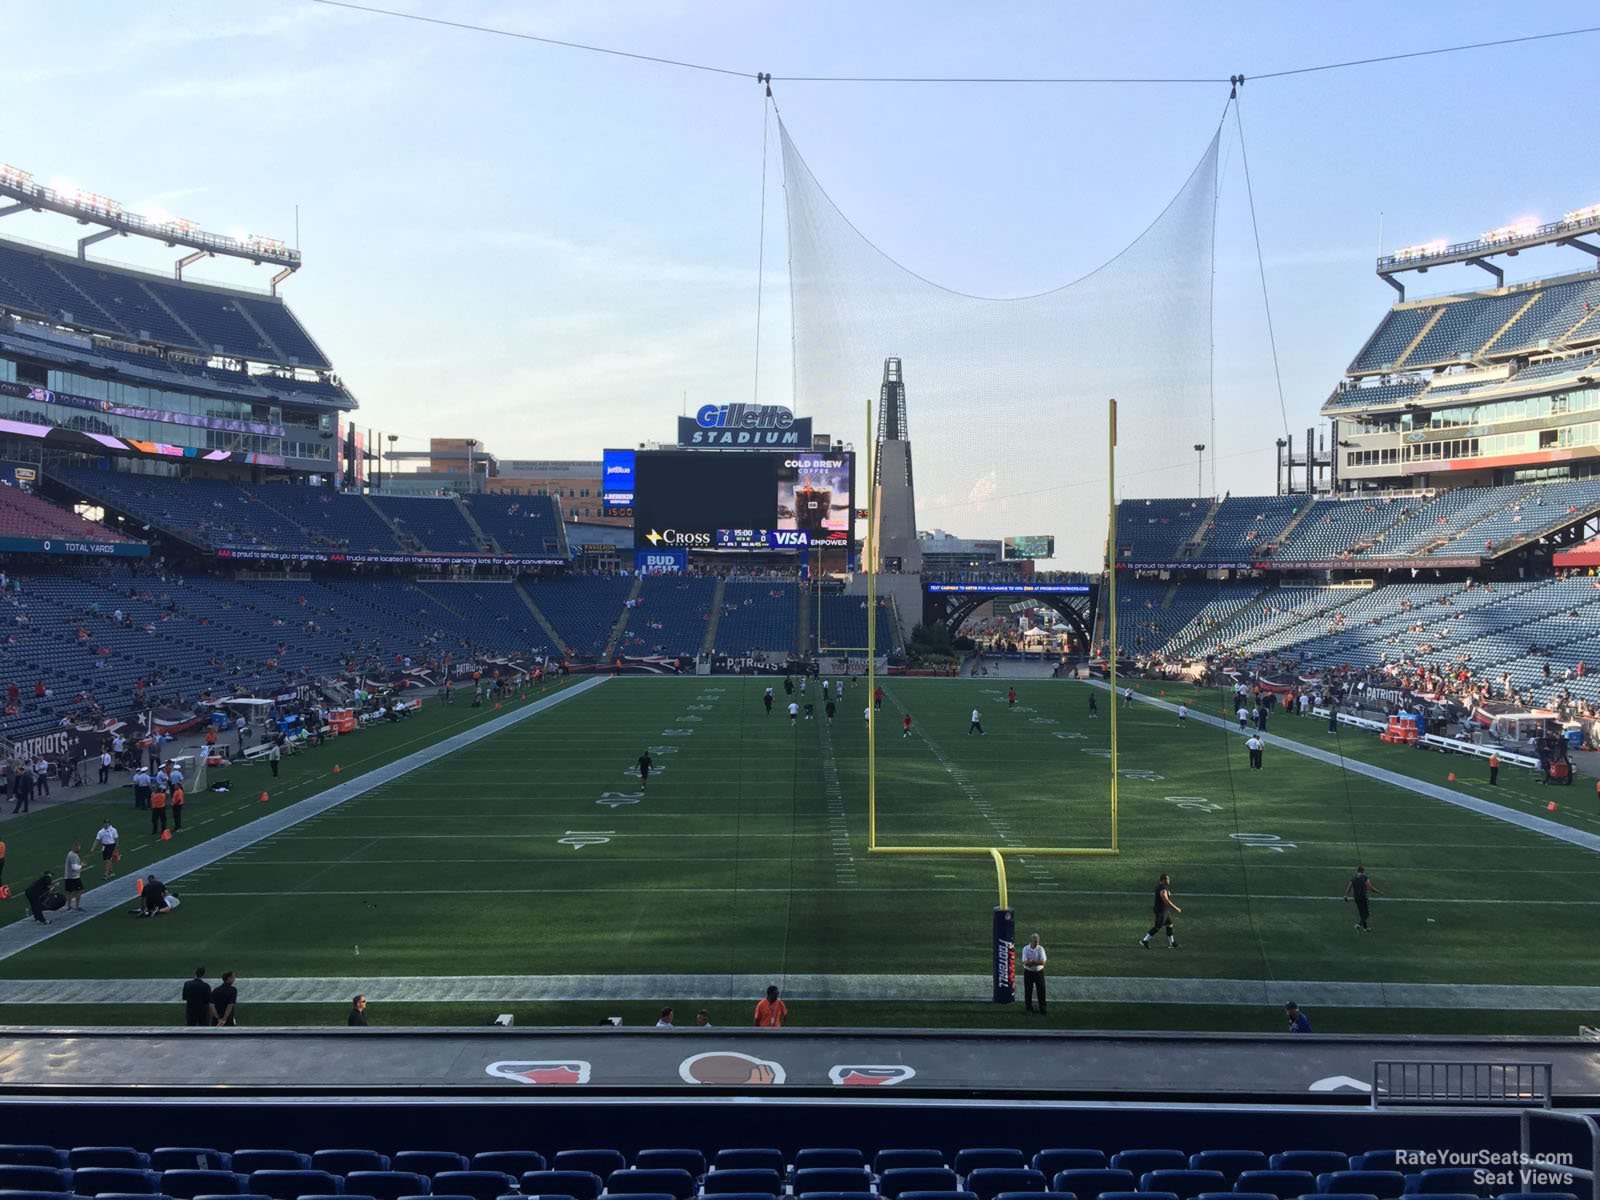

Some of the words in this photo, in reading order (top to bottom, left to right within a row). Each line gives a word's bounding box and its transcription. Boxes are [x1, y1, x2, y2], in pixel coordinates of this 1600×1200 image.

[696, 402, 794, 429] Gillette
[692, 432, 798, 444] STADIUM
[607, 466, 630, 474] jetBlue
[775, 532, 808, 544] VISA
[44, 541, 50, 550] 0
[65, 543, 88, 552] TOTAL
[90, 544, 114, 553] YARDS
[648, 556, 674, 565] BUD
[1366, 686, 1404, 708] PATRIOTS
[14, 732, 68, 760] PATRIOTS
